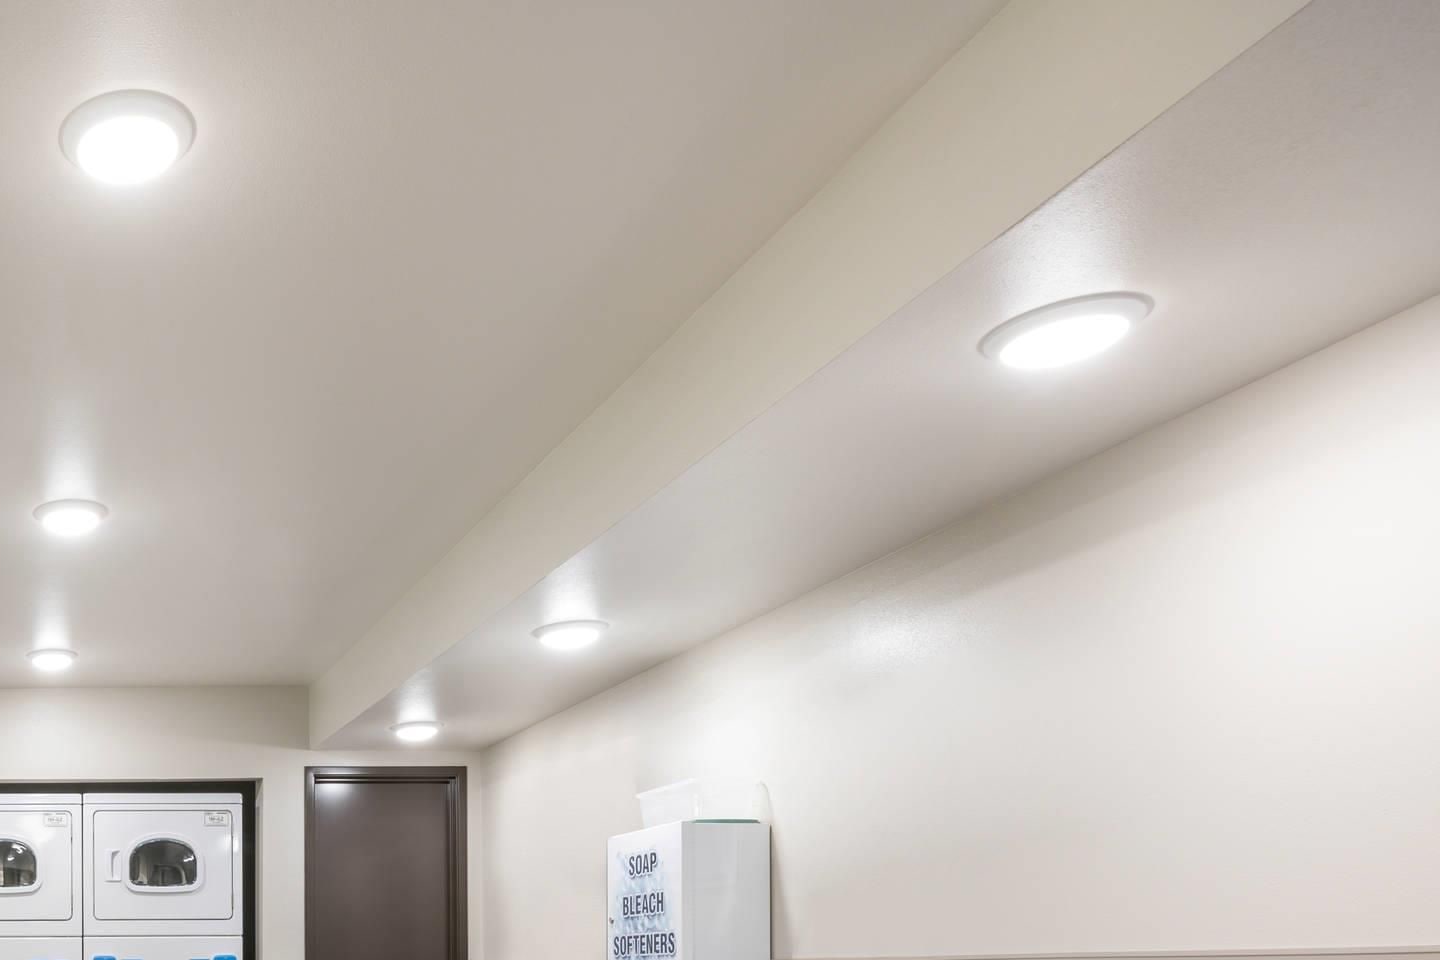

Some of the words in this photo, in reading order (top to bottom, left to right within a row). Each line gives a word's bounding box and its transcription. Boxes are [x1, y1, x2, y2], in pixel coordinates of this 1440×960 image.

[629, 852, 657, 876] SOAP
[622, 891, 664, 916] BLEACH
[613, 932, 675, 956] SOFTENERS
